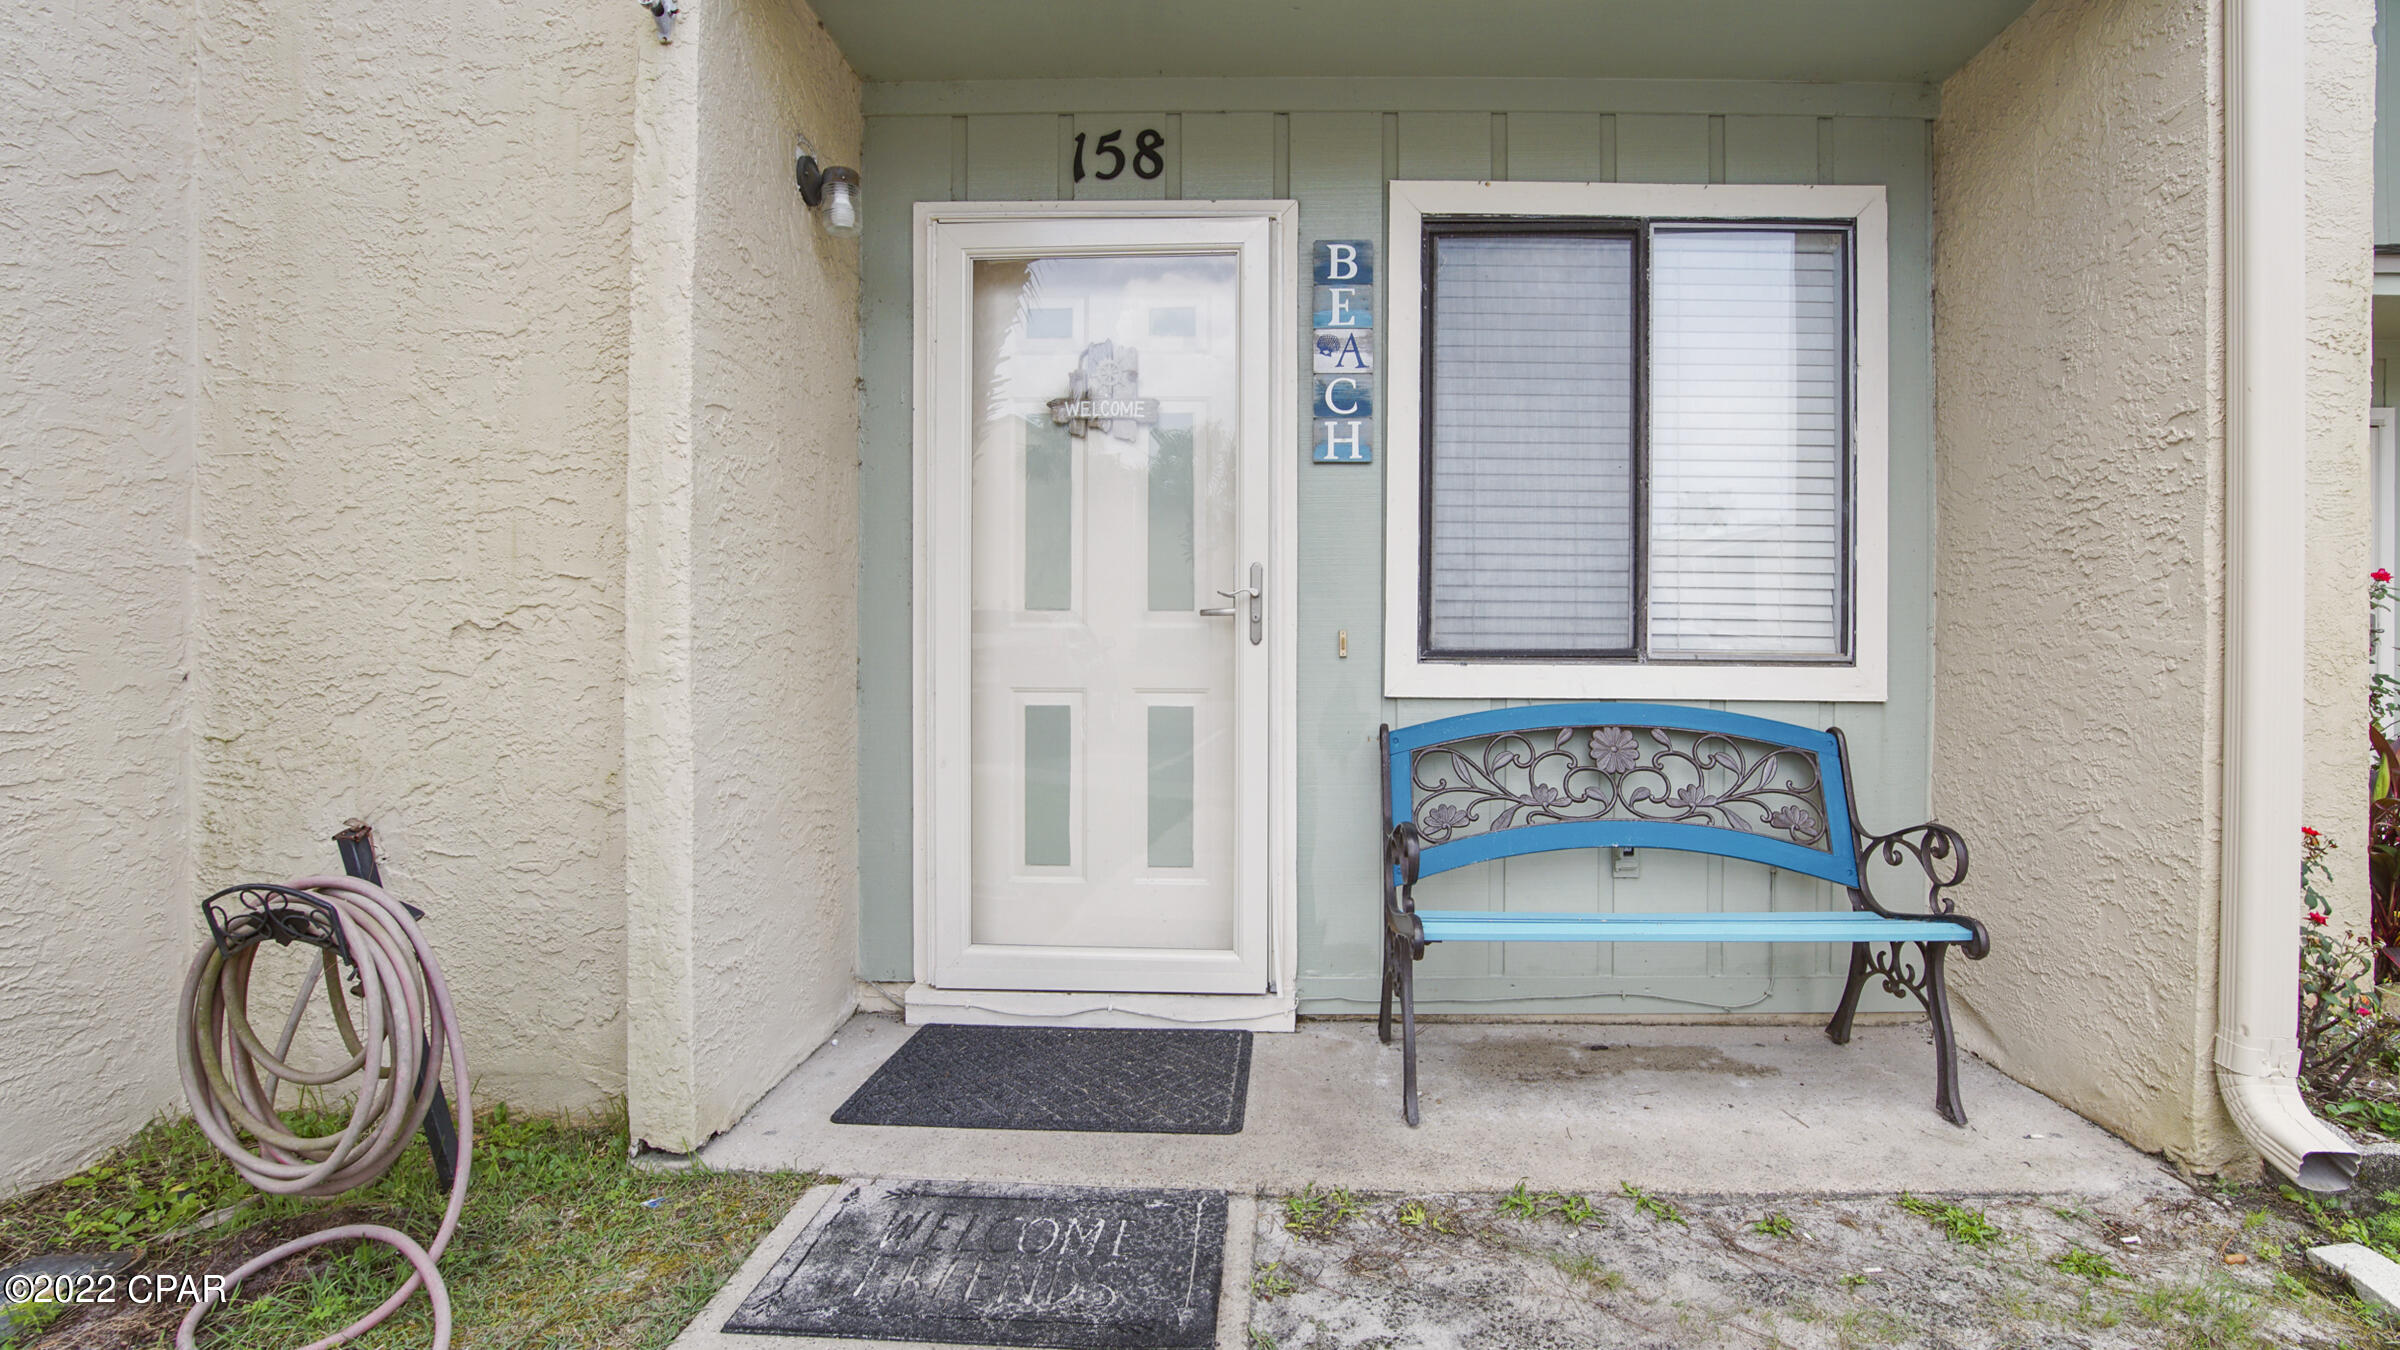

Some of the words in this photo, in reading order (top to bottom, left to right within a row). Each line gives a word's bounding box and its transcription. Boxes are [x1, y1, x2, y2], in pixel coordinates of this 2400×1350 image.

[1073, 129, 1165, 184] 158
[1323, 243, 1371, 461] BEACH
[1064, 400, 1145, 418] WELCOME
[878, 1210, 1137, 1257] WELCOME
